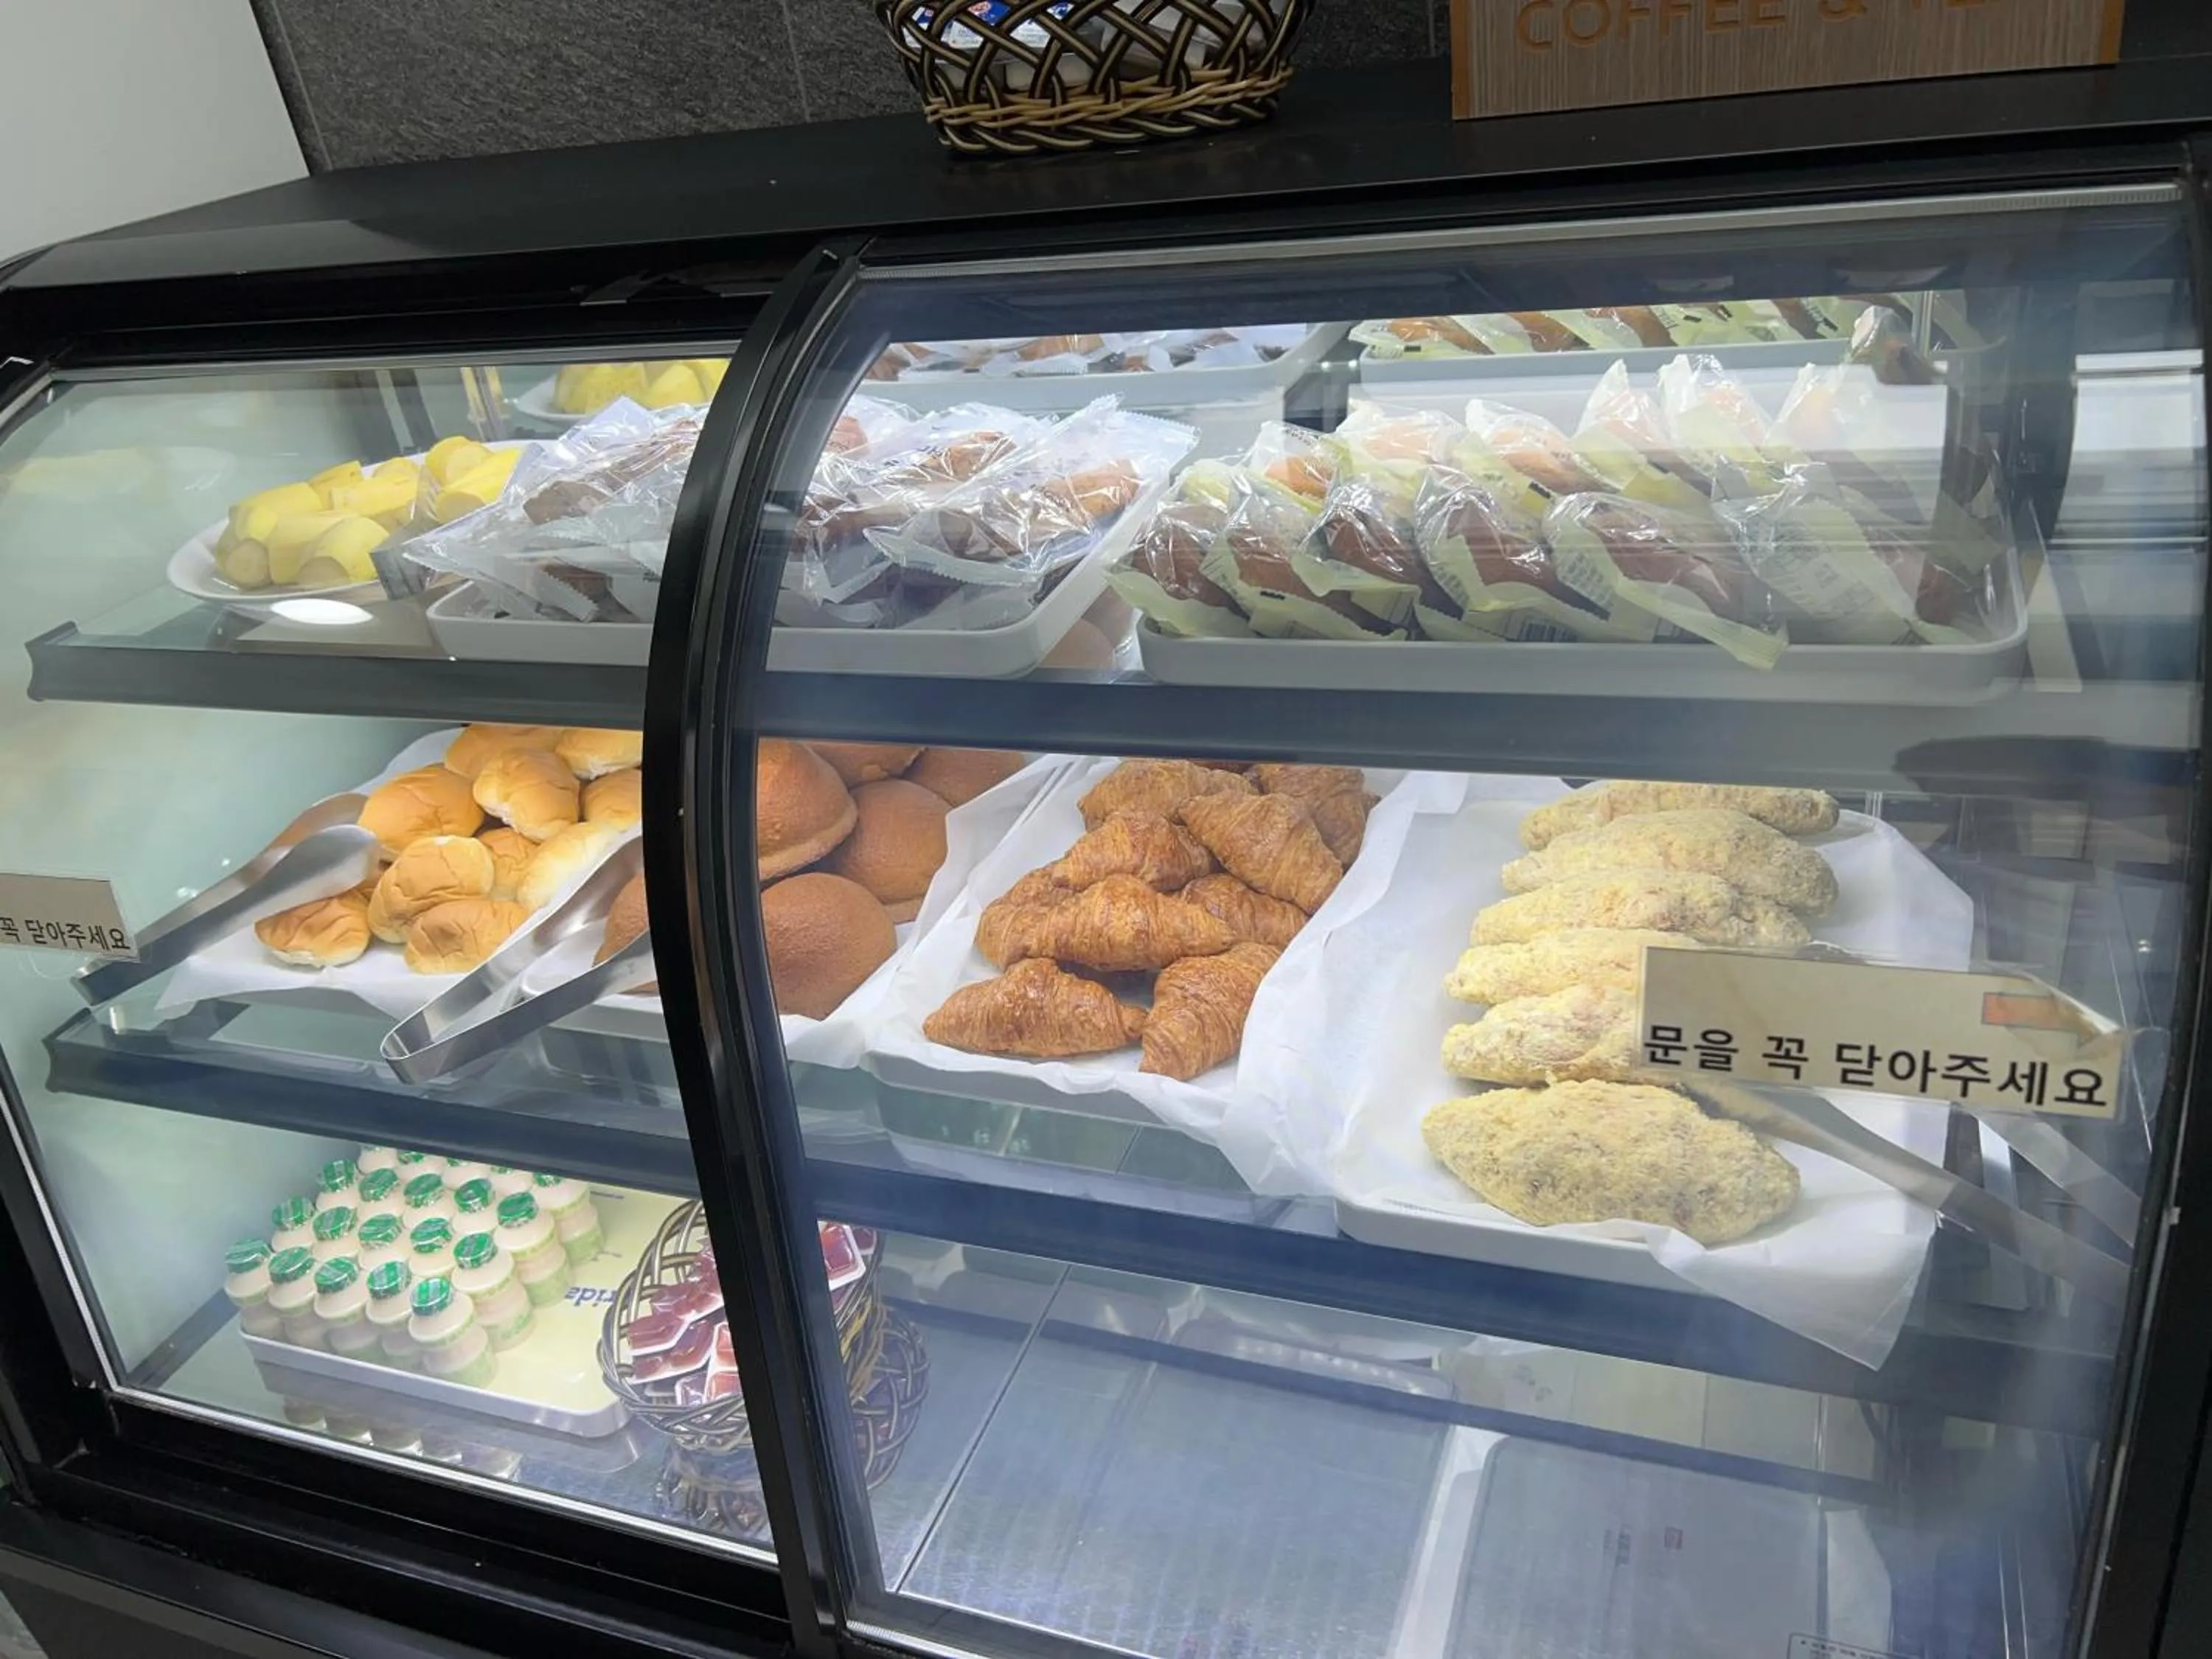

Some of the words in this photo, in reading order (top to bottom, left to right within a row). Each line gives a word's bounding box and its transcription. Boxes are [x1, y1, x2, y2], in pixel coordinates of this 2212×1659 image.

[1517, 0, 1786, 52] COFFEE
[24, 919, 131, 951] 닫아주세요
[1644, 1025, 1739, 1072] 문을
[1761, 1036, 1809, 1080] 꼭
[1835, 1043, 2107, 1106] 닫아주세요
